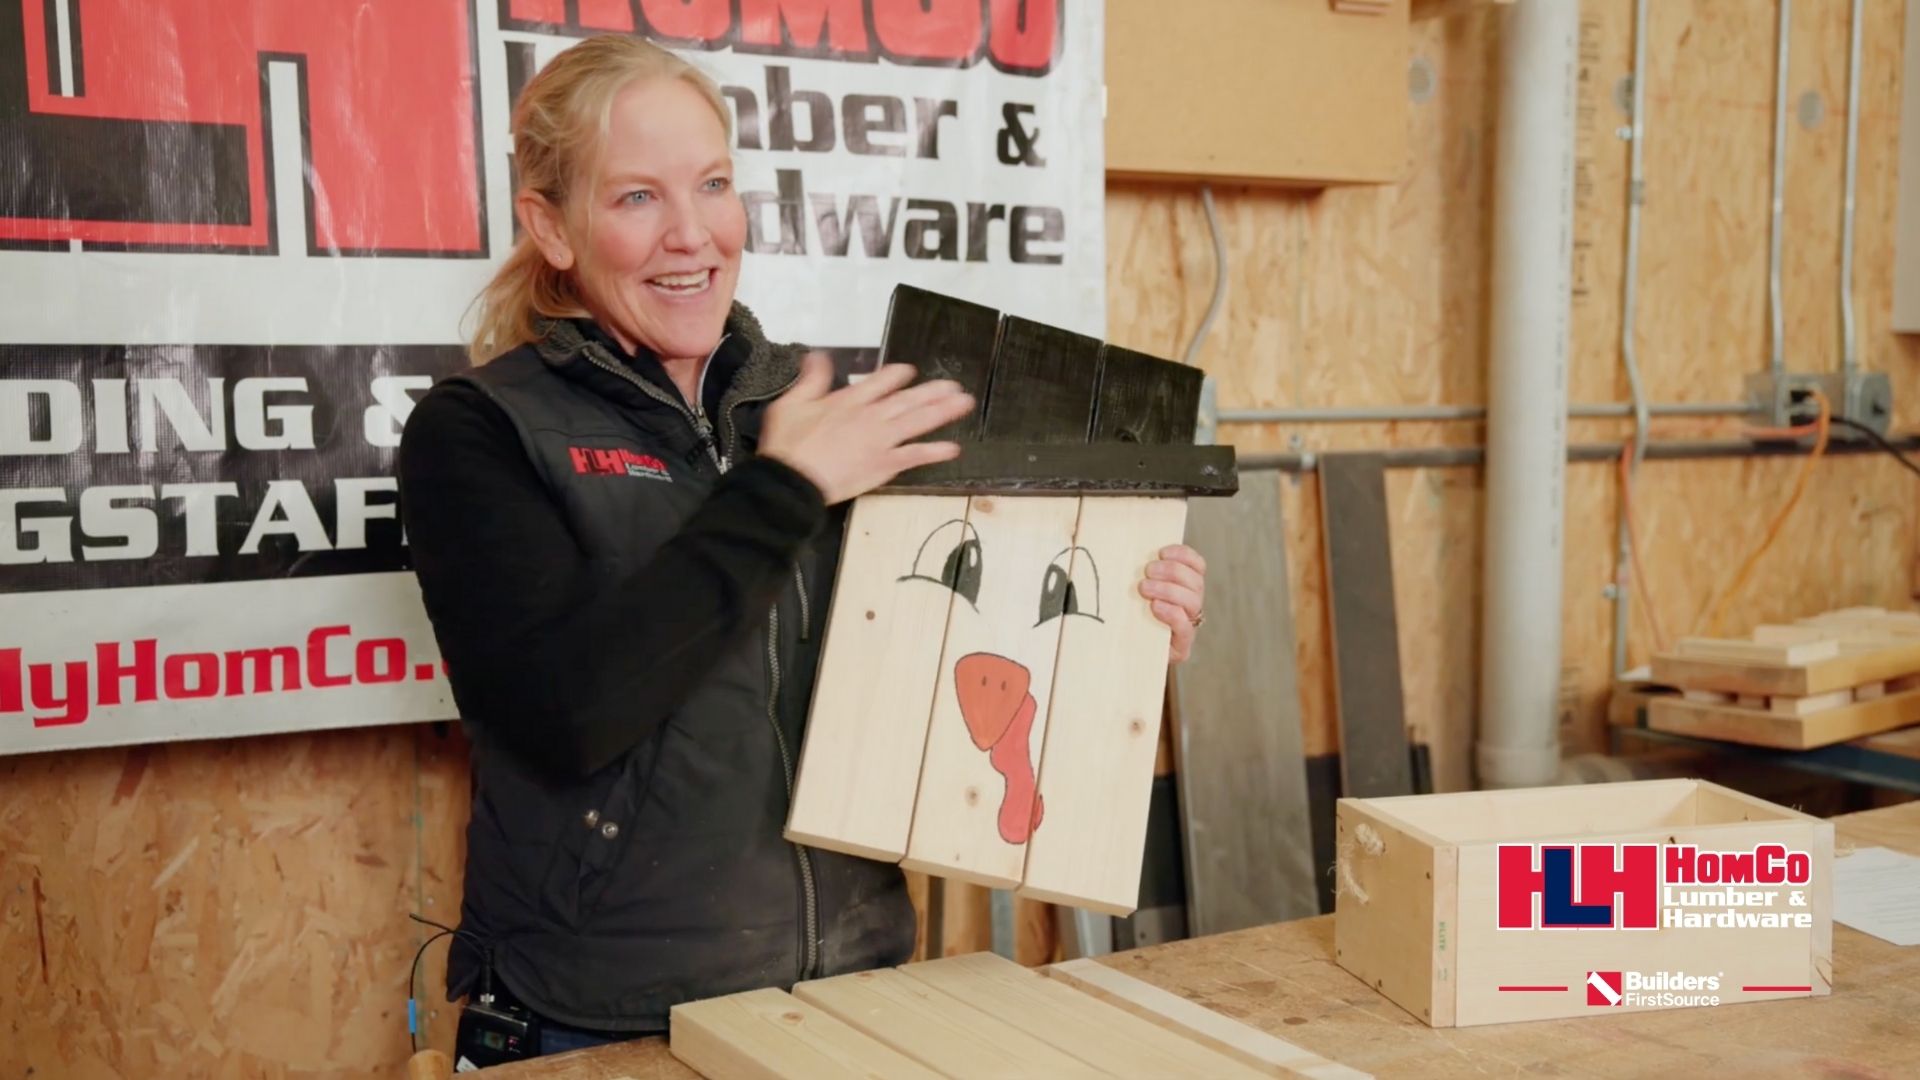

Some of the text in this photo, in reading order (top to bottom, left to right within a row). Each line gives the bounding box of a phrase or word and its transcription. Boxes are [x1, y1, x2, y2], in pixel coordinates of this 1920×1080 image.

[997, 102, 1046, 167] &
[0, 376, 433, 456] DING &
[0, 477, 407, 565] GSTAF
[0, 625, 450, 728] yHomCo.
